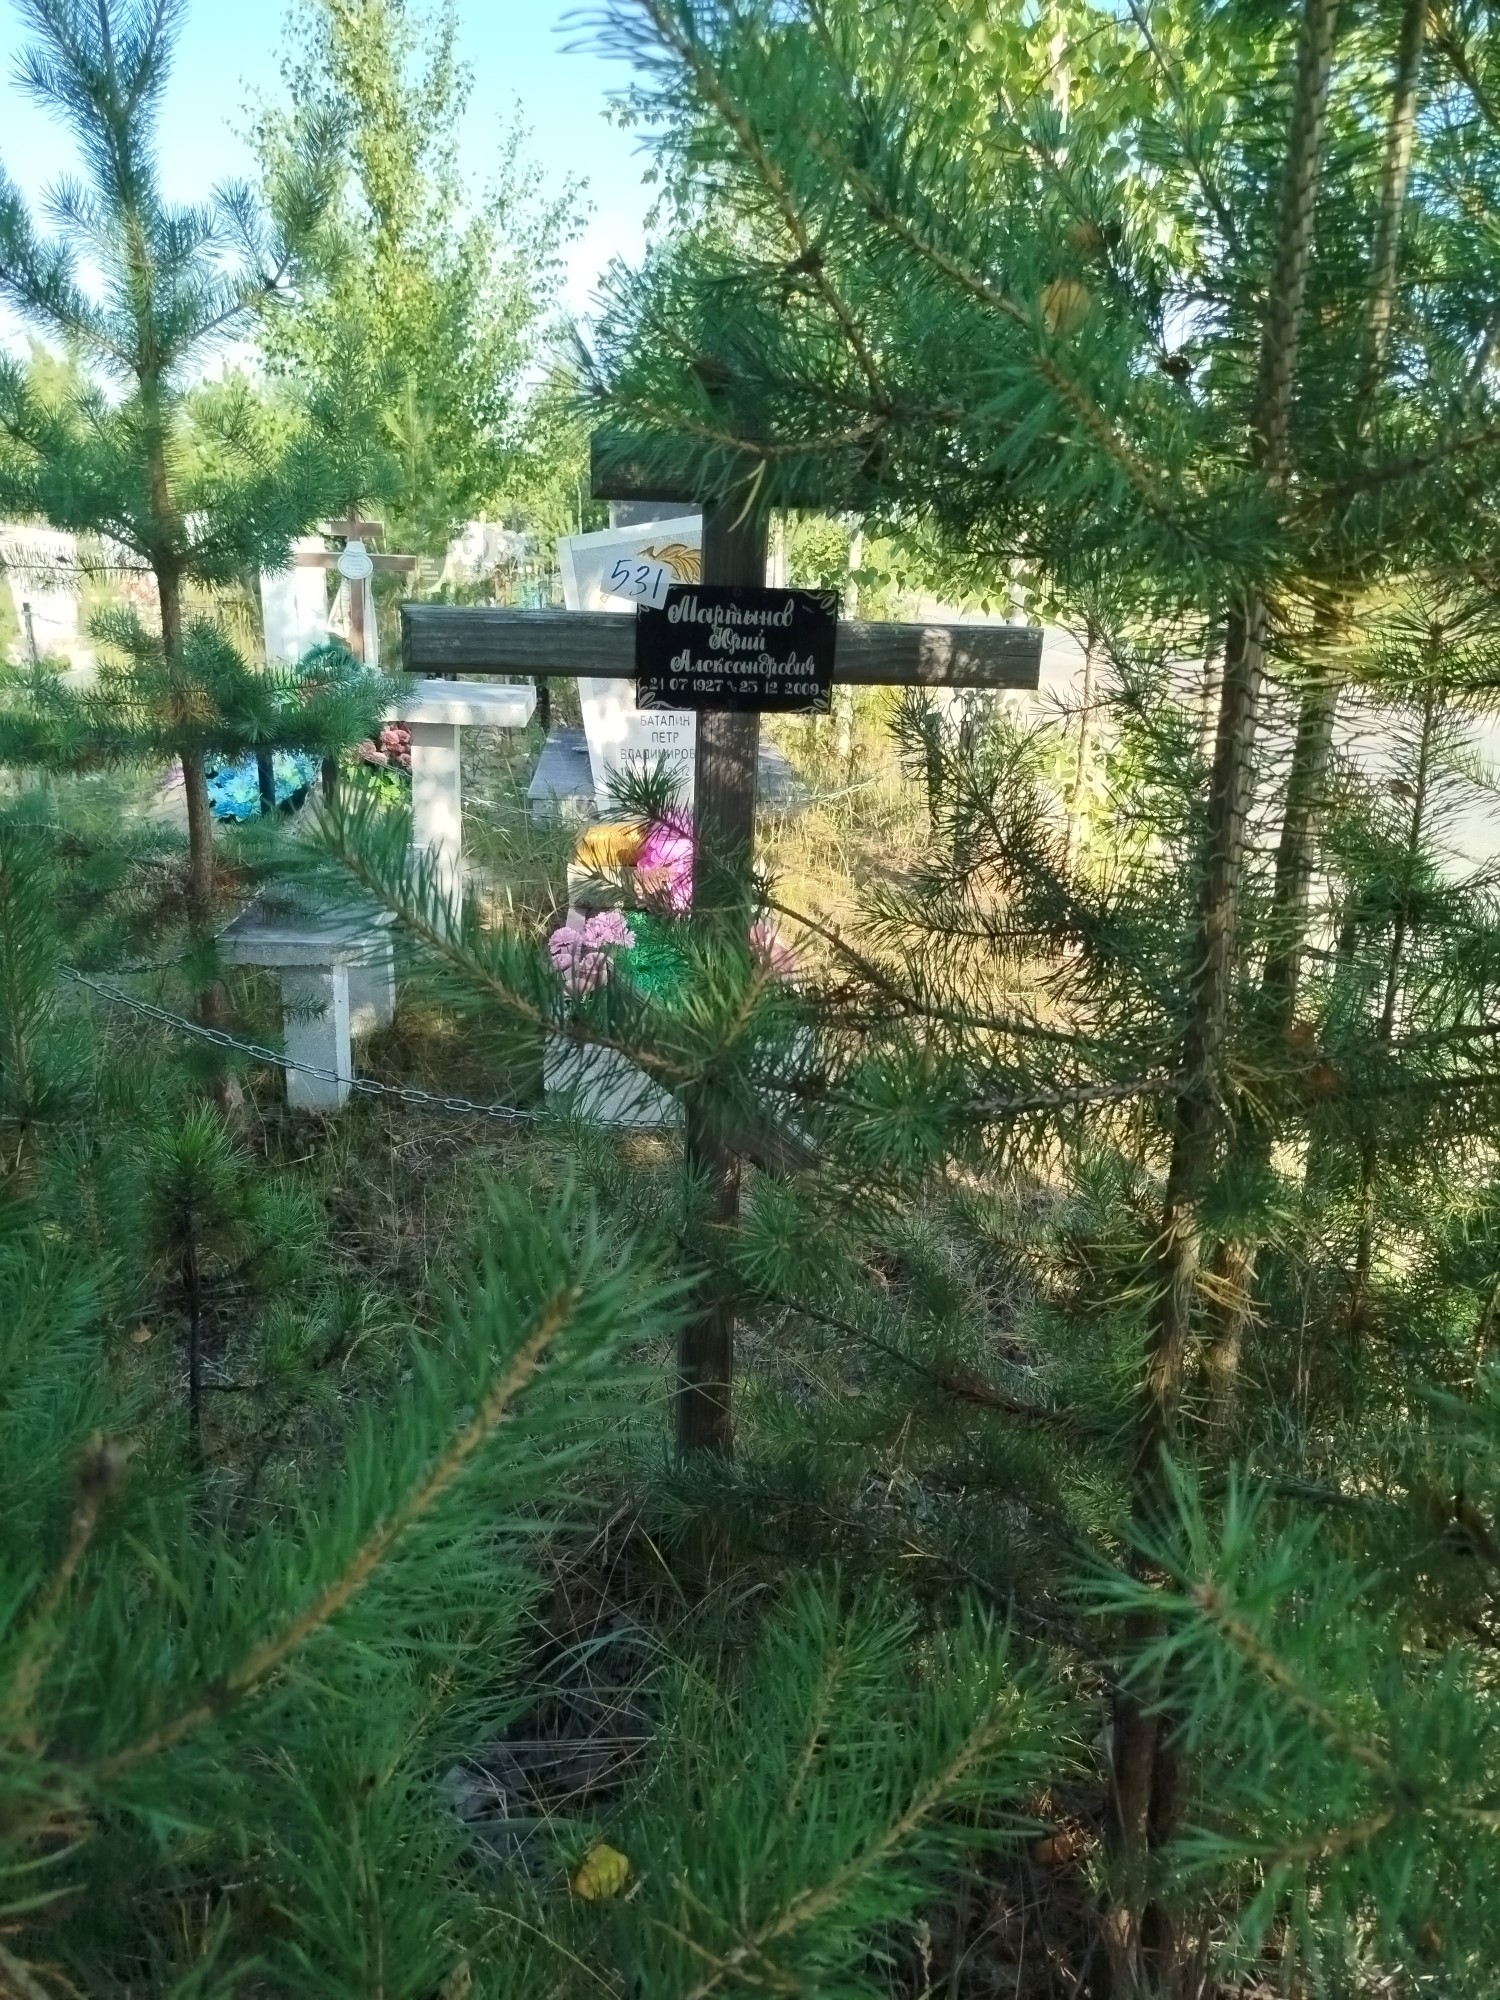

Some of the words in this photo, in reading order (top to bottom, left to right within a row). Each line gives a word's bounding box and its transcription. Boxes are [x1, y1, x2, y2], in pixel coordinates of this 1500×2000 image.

[610, 559, 663, 599] 531
[667, 595, 795, 628] Мартынов
[709, 626, 766, 655] Юрий
[670, 649, 815, 679] Александрович
[649, 677, 664, 690] 21
[669, 678, 688, 691] 07
[693, 679, 724, 692] 1927
[765, 681, 778, 695] 12
[784, 682, 819, 696] 2009
[640, 715, 690, 727] БАТАЛИН
